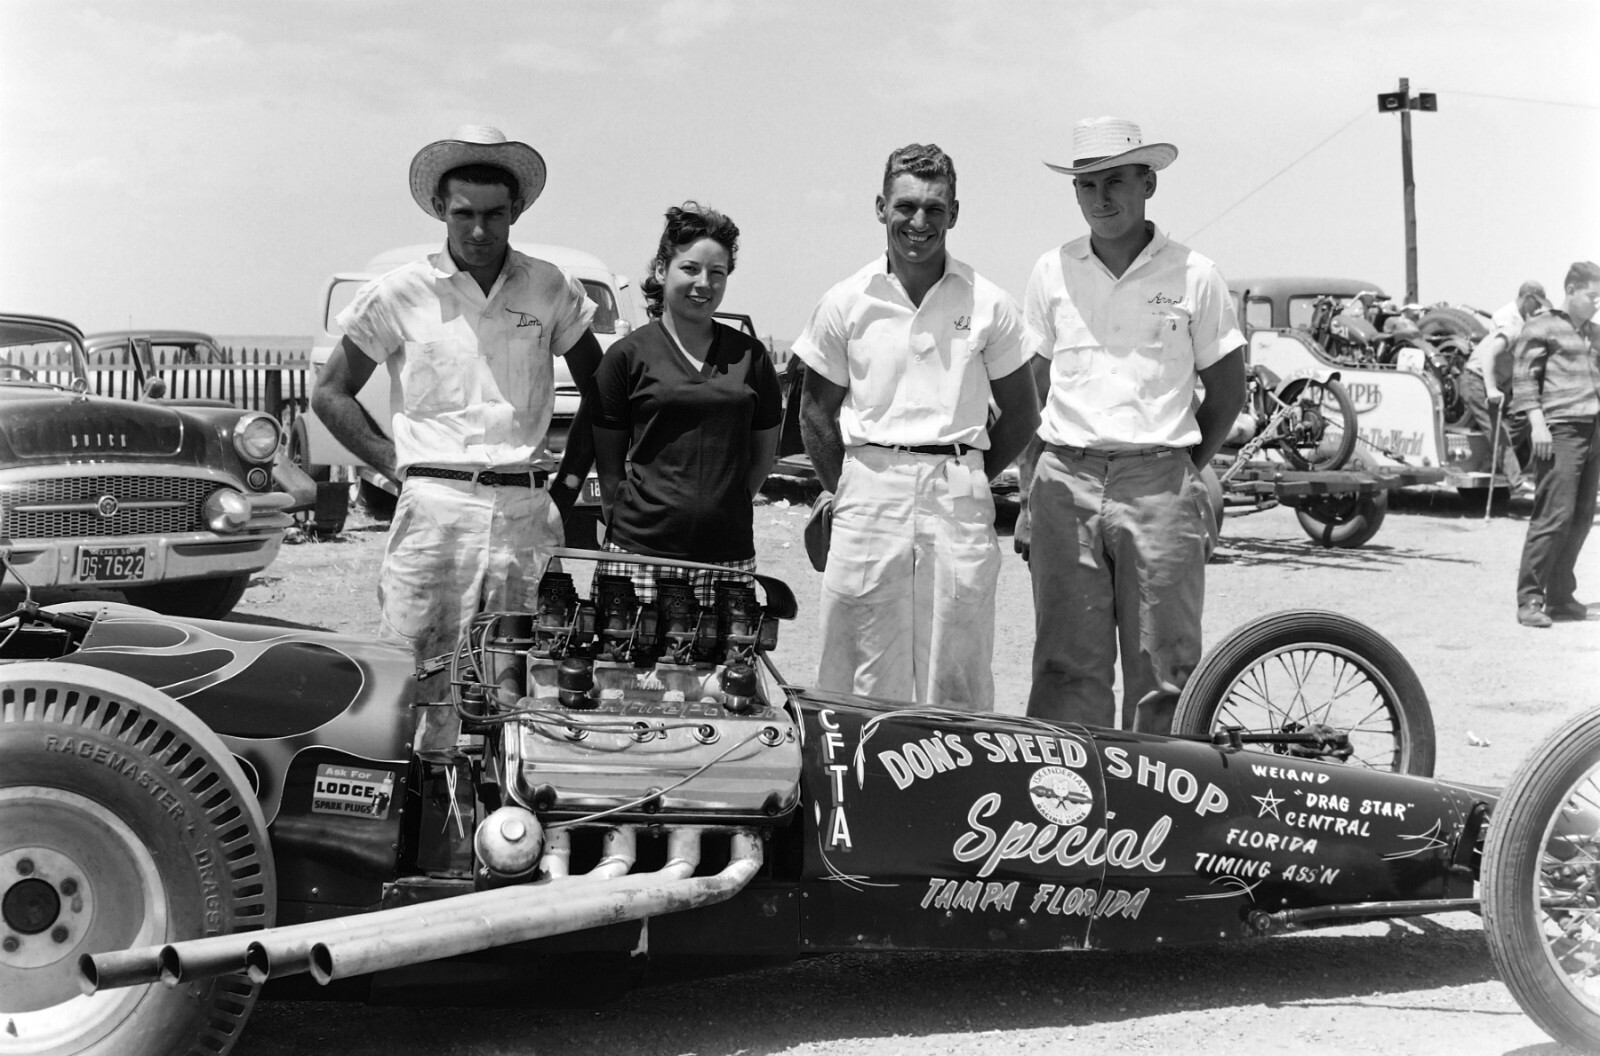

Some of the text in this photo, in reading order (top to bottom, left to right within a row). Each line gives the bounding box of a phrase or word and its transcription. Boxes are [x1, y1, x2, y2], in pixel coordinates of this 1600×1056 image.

[71, 433, 127, 448] BUICK
[1371, 428, 1389, 453] The
[1391, 430, 1424, 456] World
[45, 735, 185, 821] RACEMASTER
[325, 767, 372, 779] Ask For
[878, 730, 1229, 817] DON'S SPEED SHOP
[1033, 767, 1089, 793] ISKENDERIAN
[1251, 764, 1330, 784] WEIAND
[316, 781, 375, 798] LODGE
[314, 800, 372, 814] SPARK PLUGS
[1036, 803, 1063, 825] RACING
[1066, 811, 1086, 825] CAMS
[952, 792, 1172, 877] Special
[1285, 811, 1371, 837] CENTRAL
[1226, 828, 1318, 854] FLORIDA
[1194, 852, 1340, 885] TIMING ASS'N
[920, 877, 1150, 919] TAMPA FLORIDA
